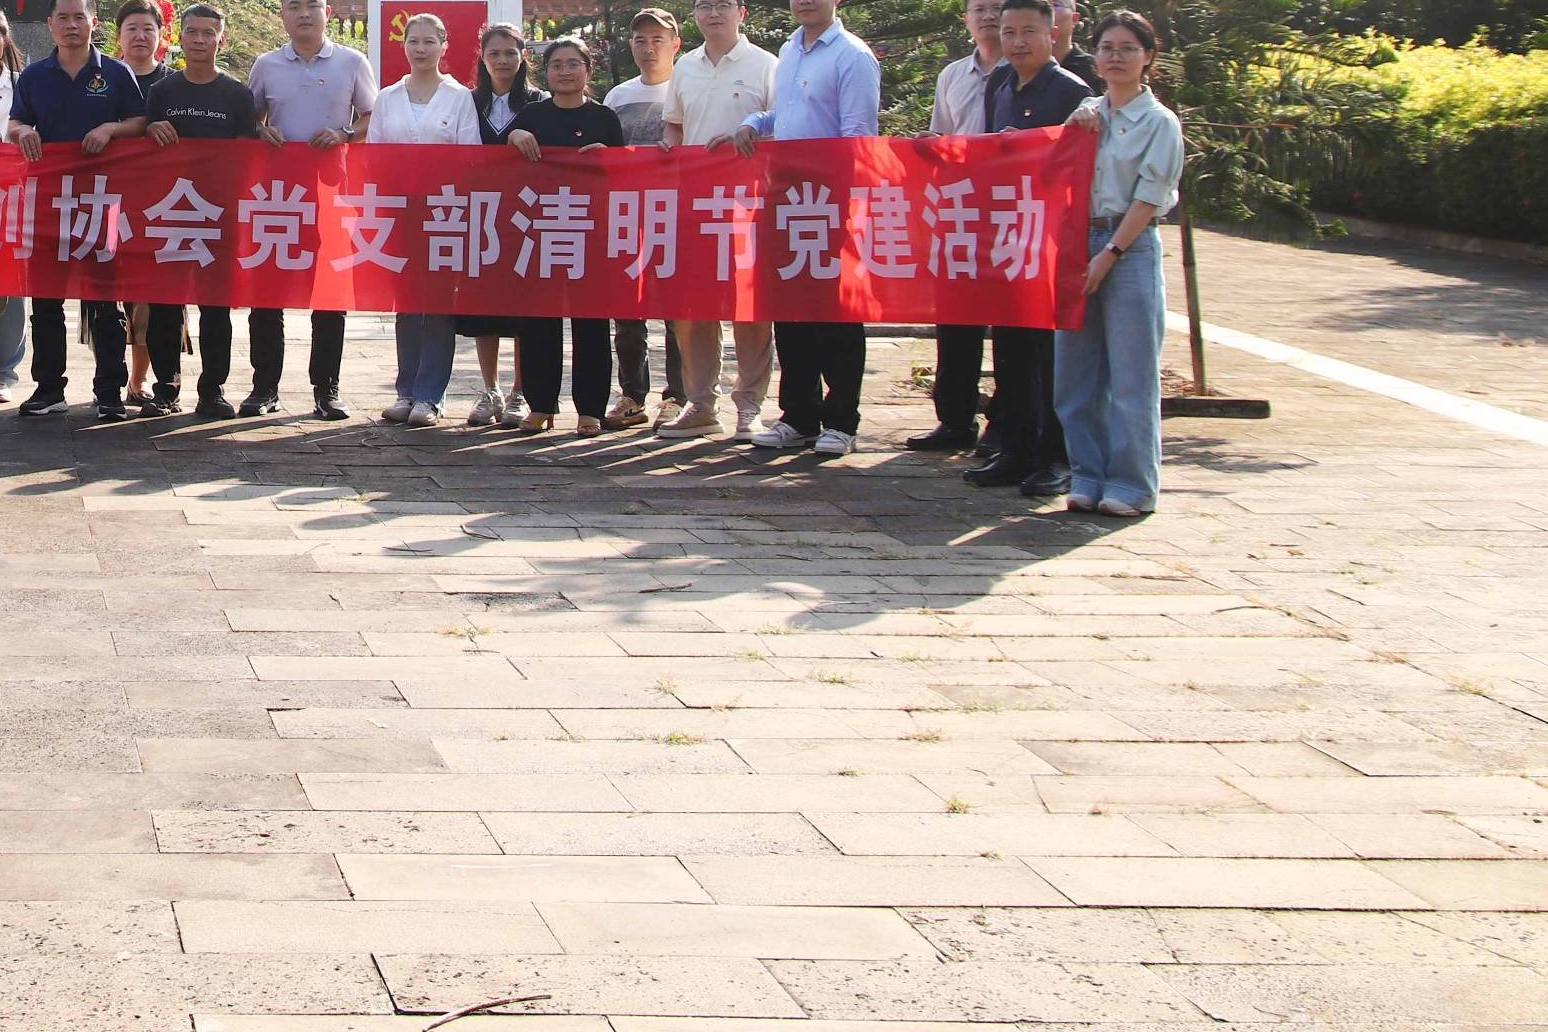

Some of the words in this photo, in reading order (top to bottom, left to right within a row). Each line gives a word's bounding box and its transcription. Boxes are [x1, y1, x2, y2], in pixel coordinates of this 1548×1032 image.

[166, 107, 187, 117] Calvin
[187, 107, 205, 116] Klein
[205, 108, 227, 119] Jeans
